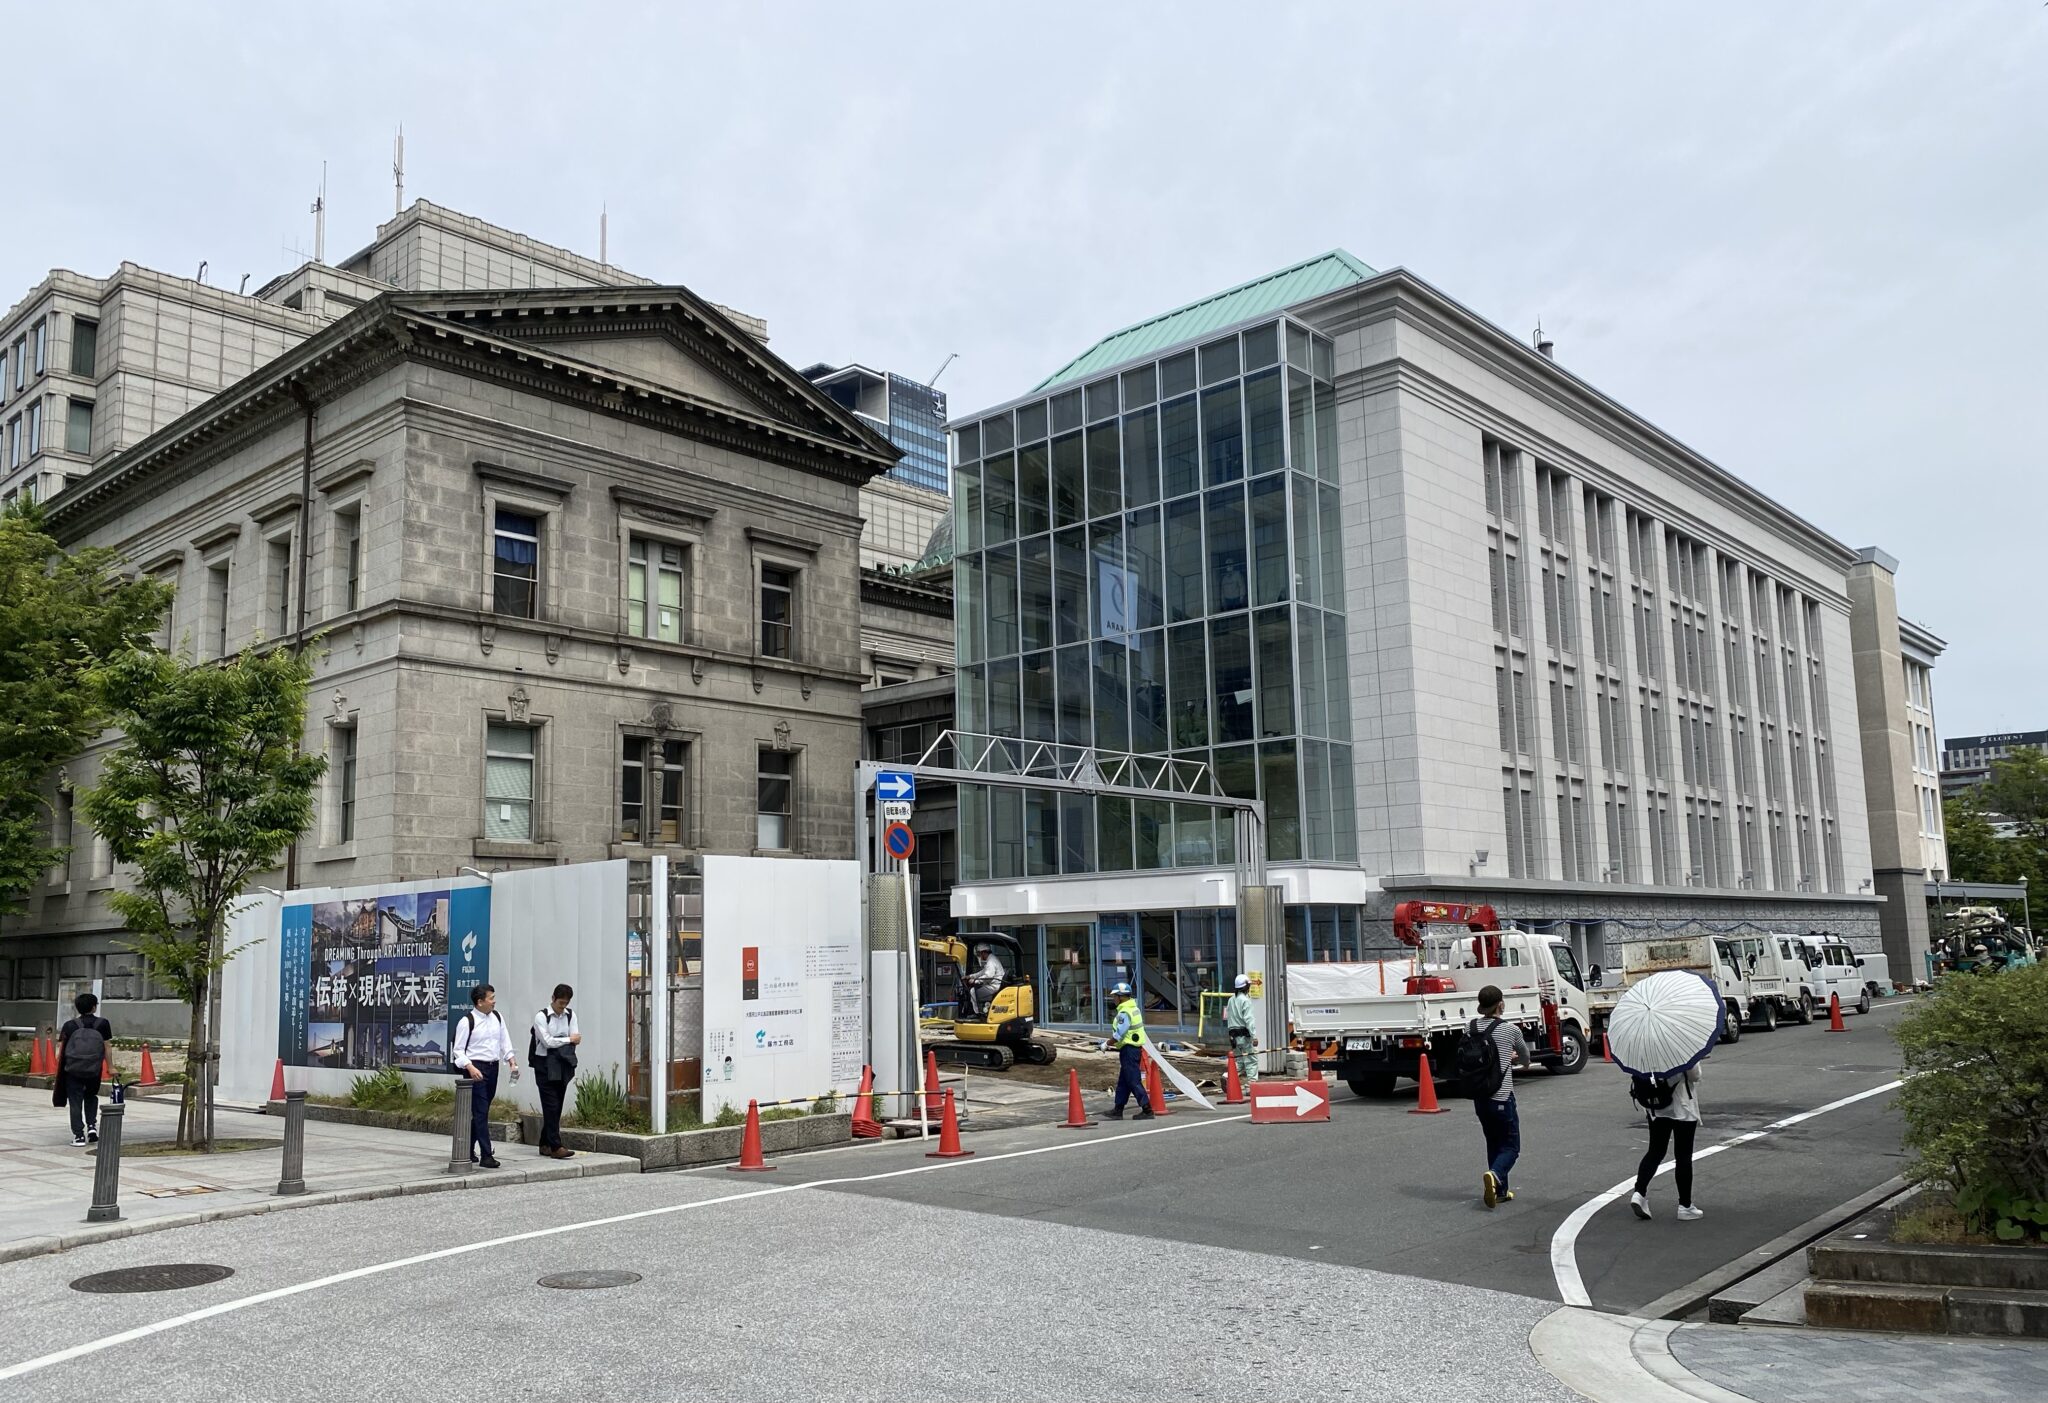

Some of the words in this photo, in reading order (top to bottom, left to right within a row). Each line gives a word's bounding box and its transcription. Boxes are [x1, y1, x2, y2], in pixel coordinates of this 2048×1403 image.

[324, 946, 355, 961] DREAMING
[357, 946, 382, 963] Through
[384, 942, 432, 957] ARCHITECTURE
